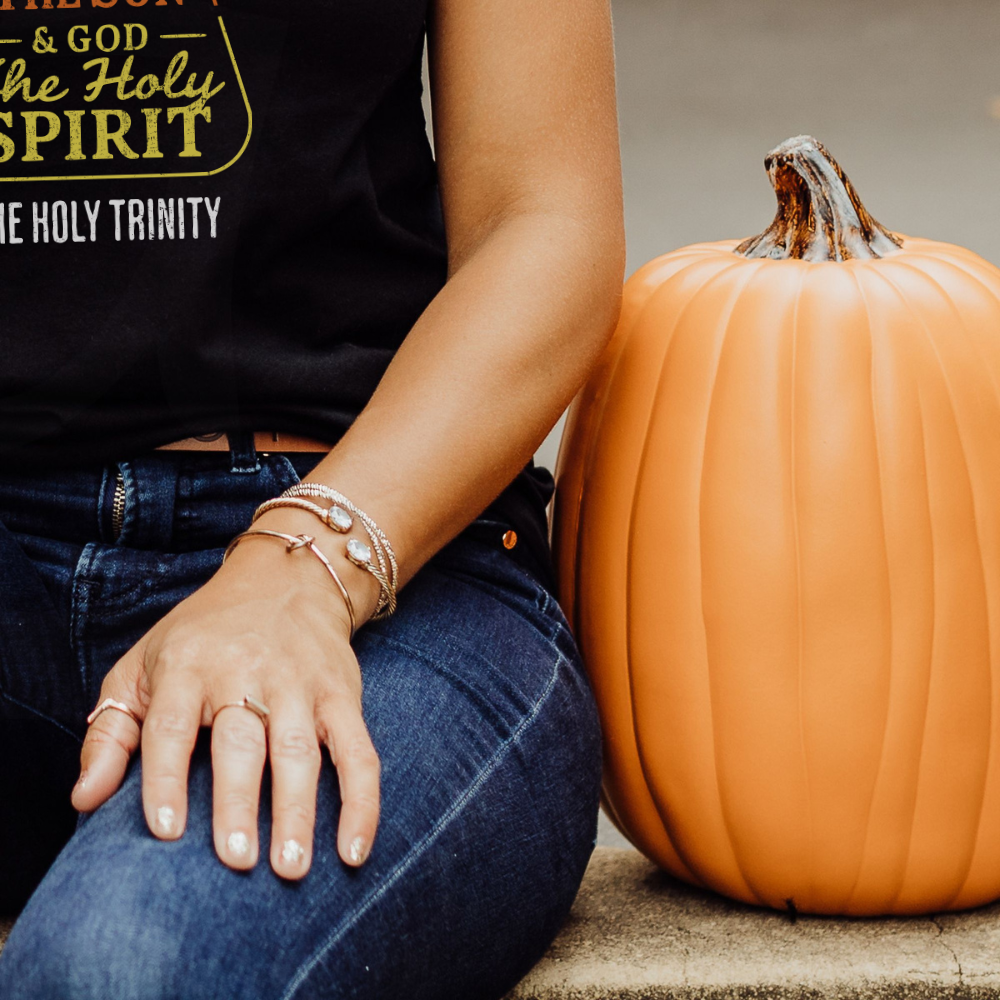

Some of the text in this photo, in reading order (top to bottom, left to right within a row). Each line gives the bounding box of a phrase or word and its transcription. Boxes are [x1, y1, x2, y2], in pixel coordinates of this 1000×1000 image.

[31, 23, 148, 54] & GOD
[82, 50, 226, 113] Holy
[32, 199, 101, 244] HOLY
[108, 196, 221, 242] TRINITY
